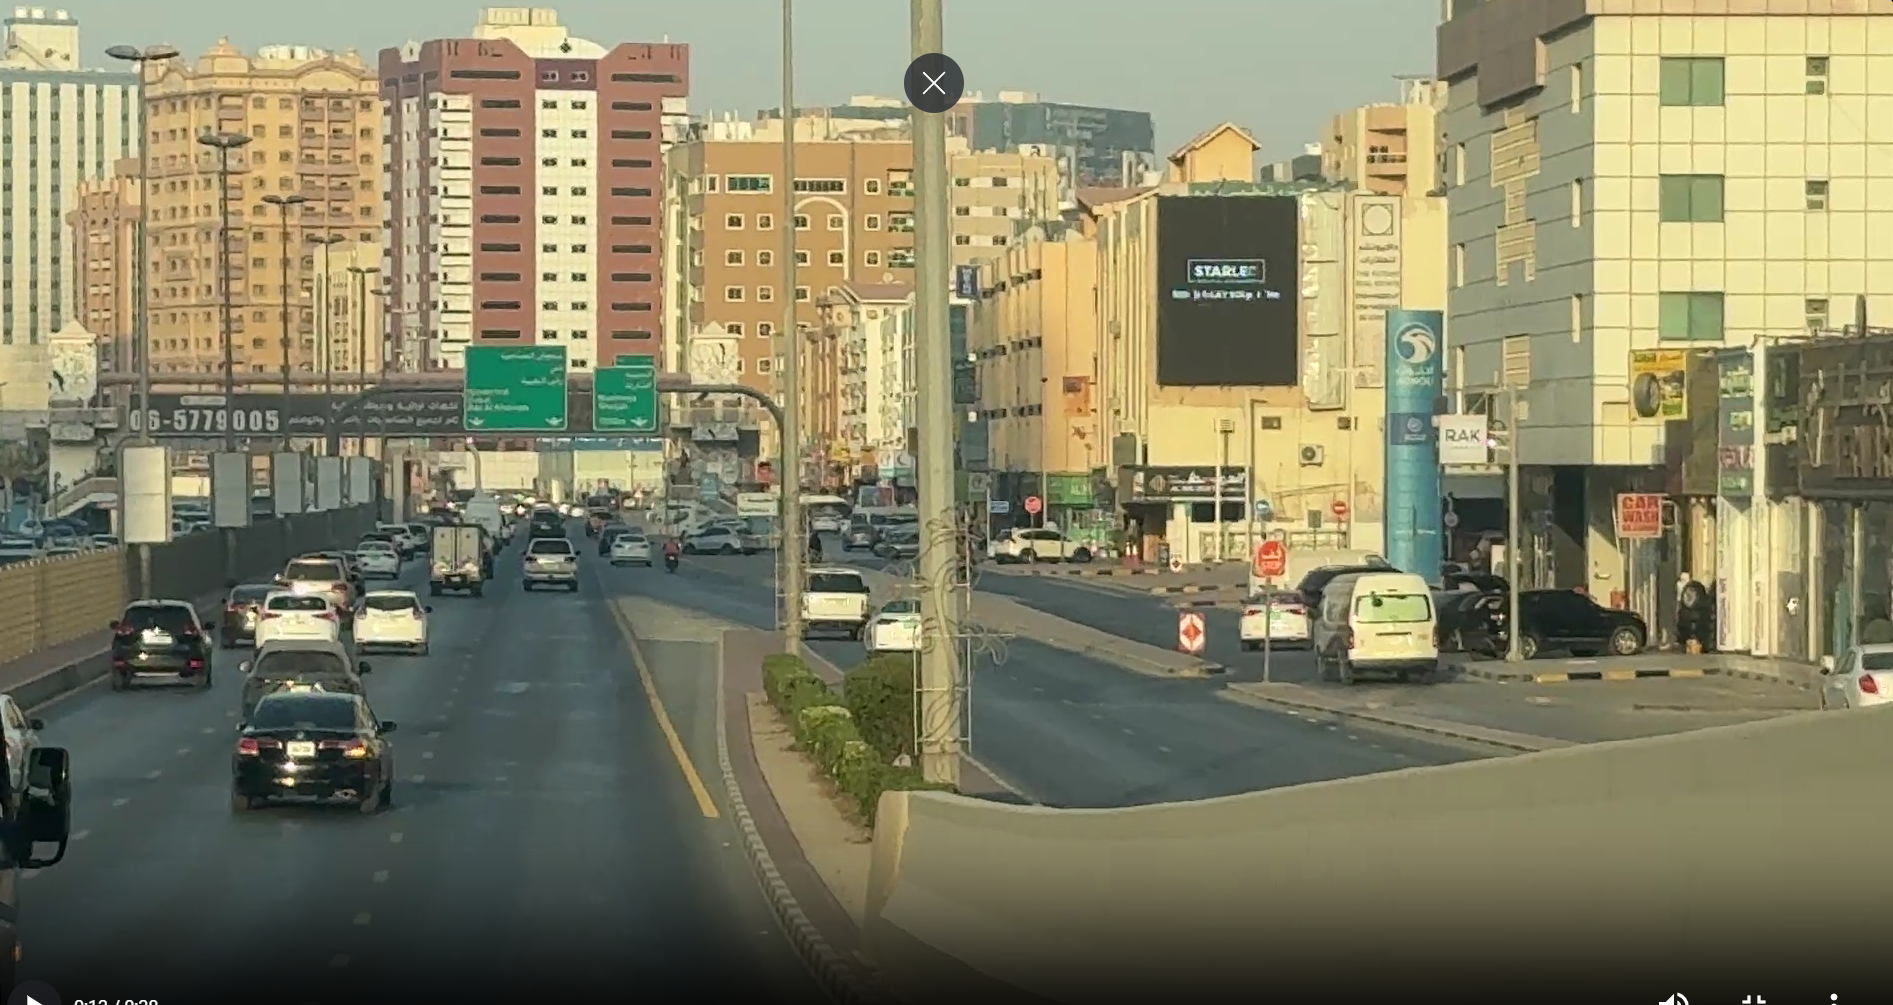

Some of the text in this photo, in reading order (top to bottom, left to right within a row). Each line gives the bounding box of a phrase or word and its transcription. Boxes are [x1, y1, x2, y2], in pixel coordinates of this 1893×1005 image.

[129, 409, 279, 431] 06-5779005
[1445, 428, 1481, 443] RAK
[1622, 496, 1659, 510] CAR
